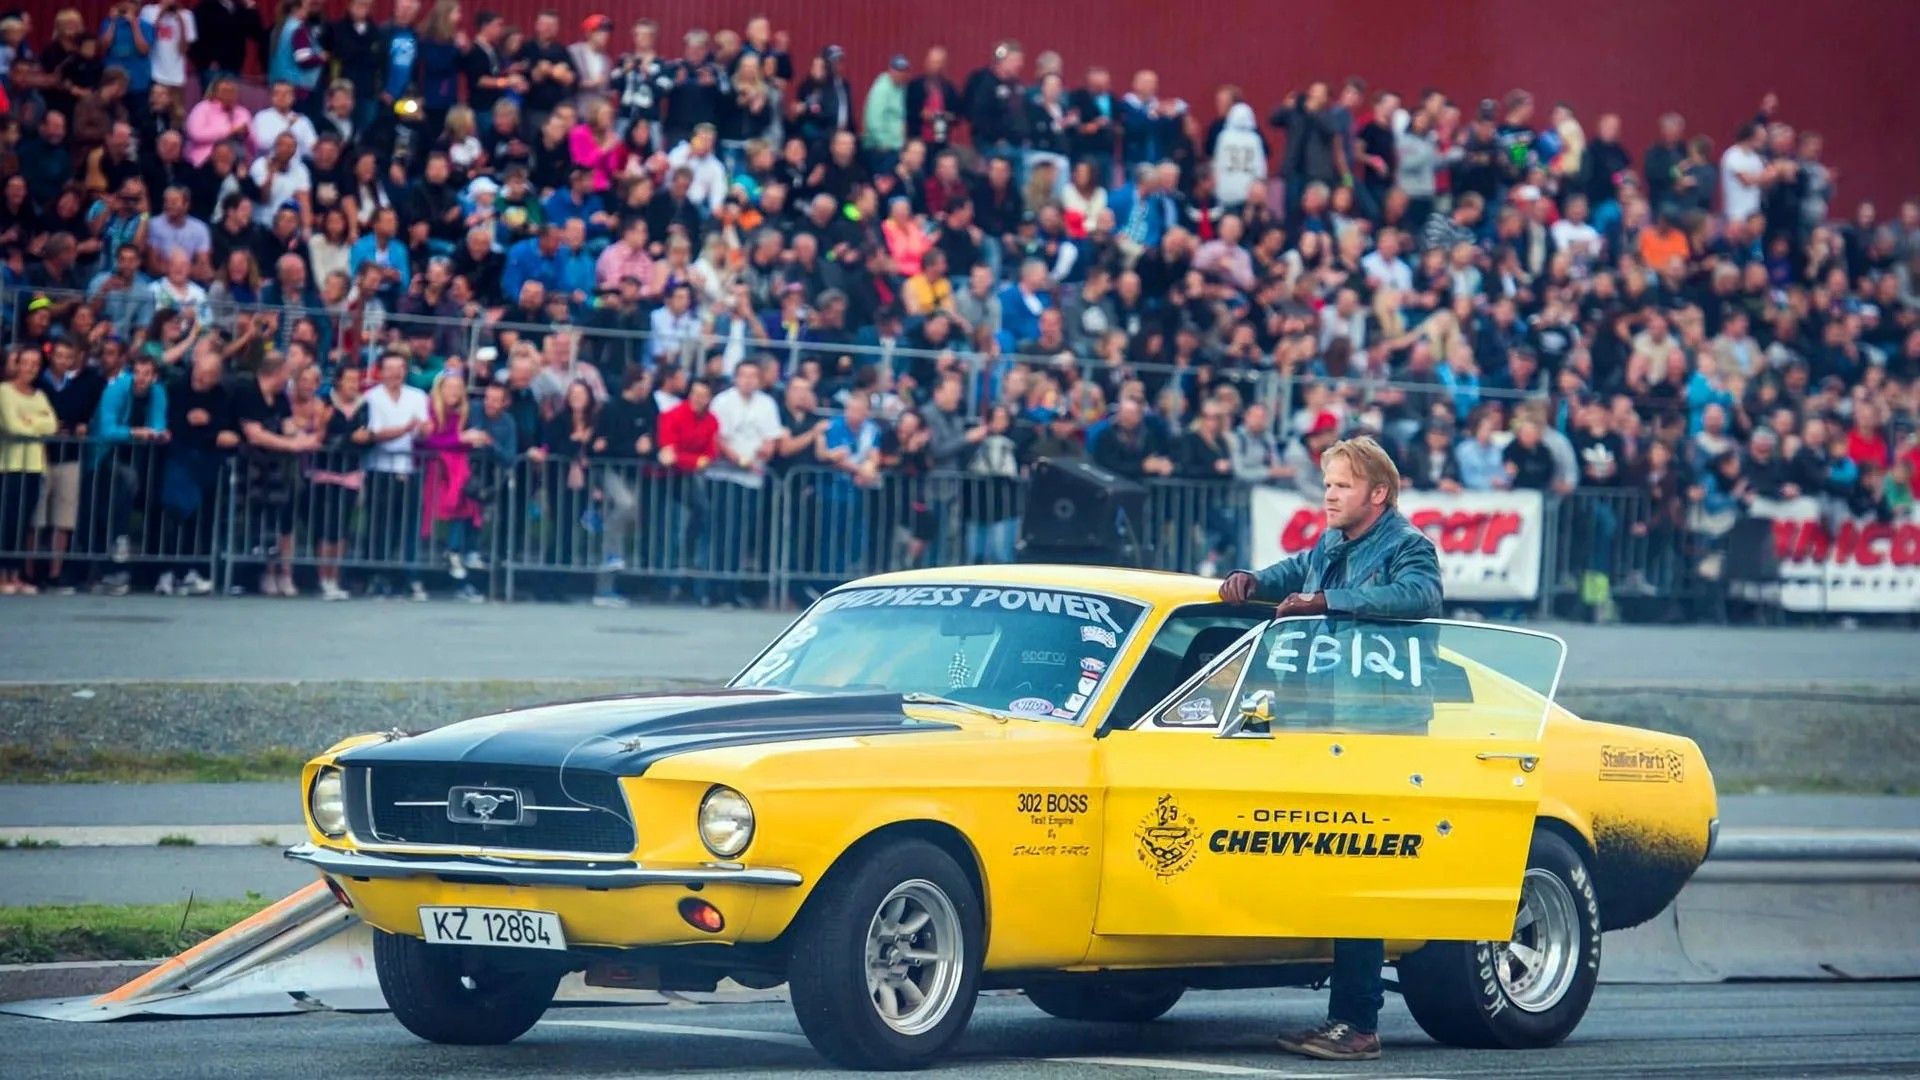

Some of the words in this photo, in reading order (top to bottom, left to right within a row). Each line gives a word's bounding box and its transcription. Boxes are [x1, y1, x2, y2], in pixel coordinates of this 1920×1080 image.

[1281, 509, 1521, 553] acar
[972, 588, 1123, 633] POWER
[1266, 631, 1422, 687] EB121
[1017, 793, 1042, 813] 302
[1047, 793, 1088, 813] BOSS
[1160, 805, 1178, 821] 25
[1253, 809, 1374, 824] OFFICIAL
[1208, 829, 1424, 858] CHEVY-KILLER
[433, 909, 472, 941] KZ
[483, 912, 551, 945] 12864
